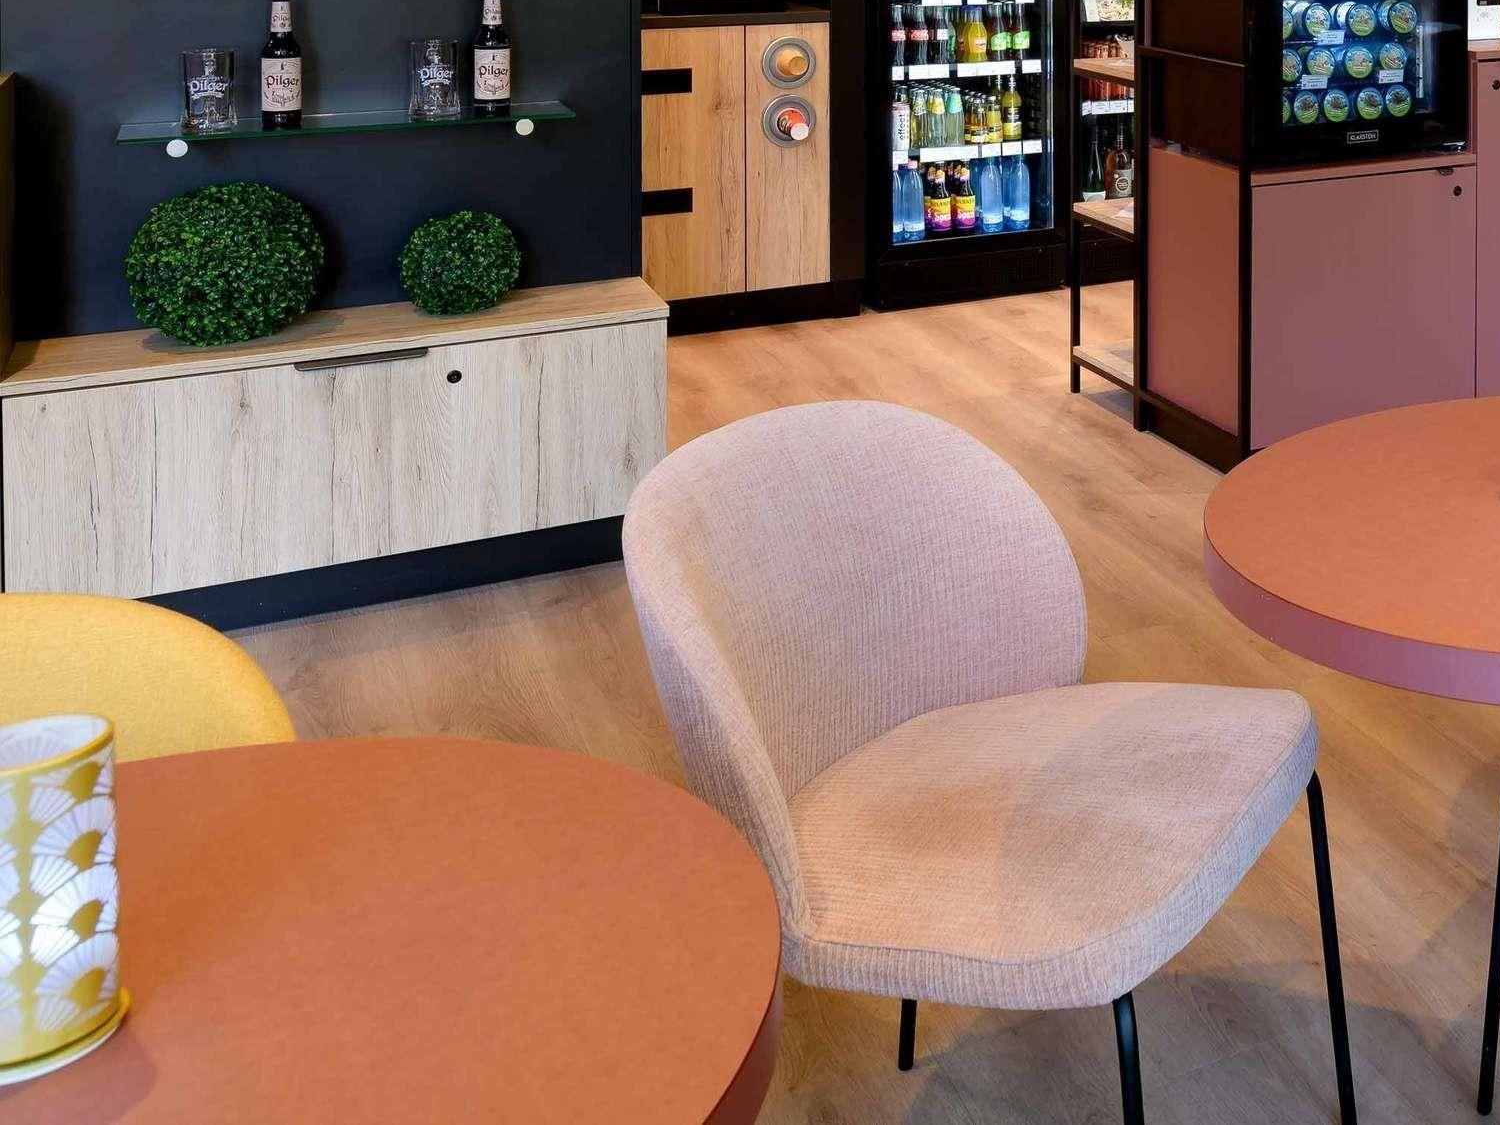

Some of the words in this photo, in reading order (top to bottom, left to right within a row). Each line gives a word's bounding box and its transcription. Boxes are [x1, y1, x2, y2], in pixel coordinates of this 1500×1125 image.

[417, 67, 454, 81] Pilger
[478, 65, 510, 78] Pilger
[187, 79, 229, 94] Pilger
[264, 74, 300, 89] Pilger
